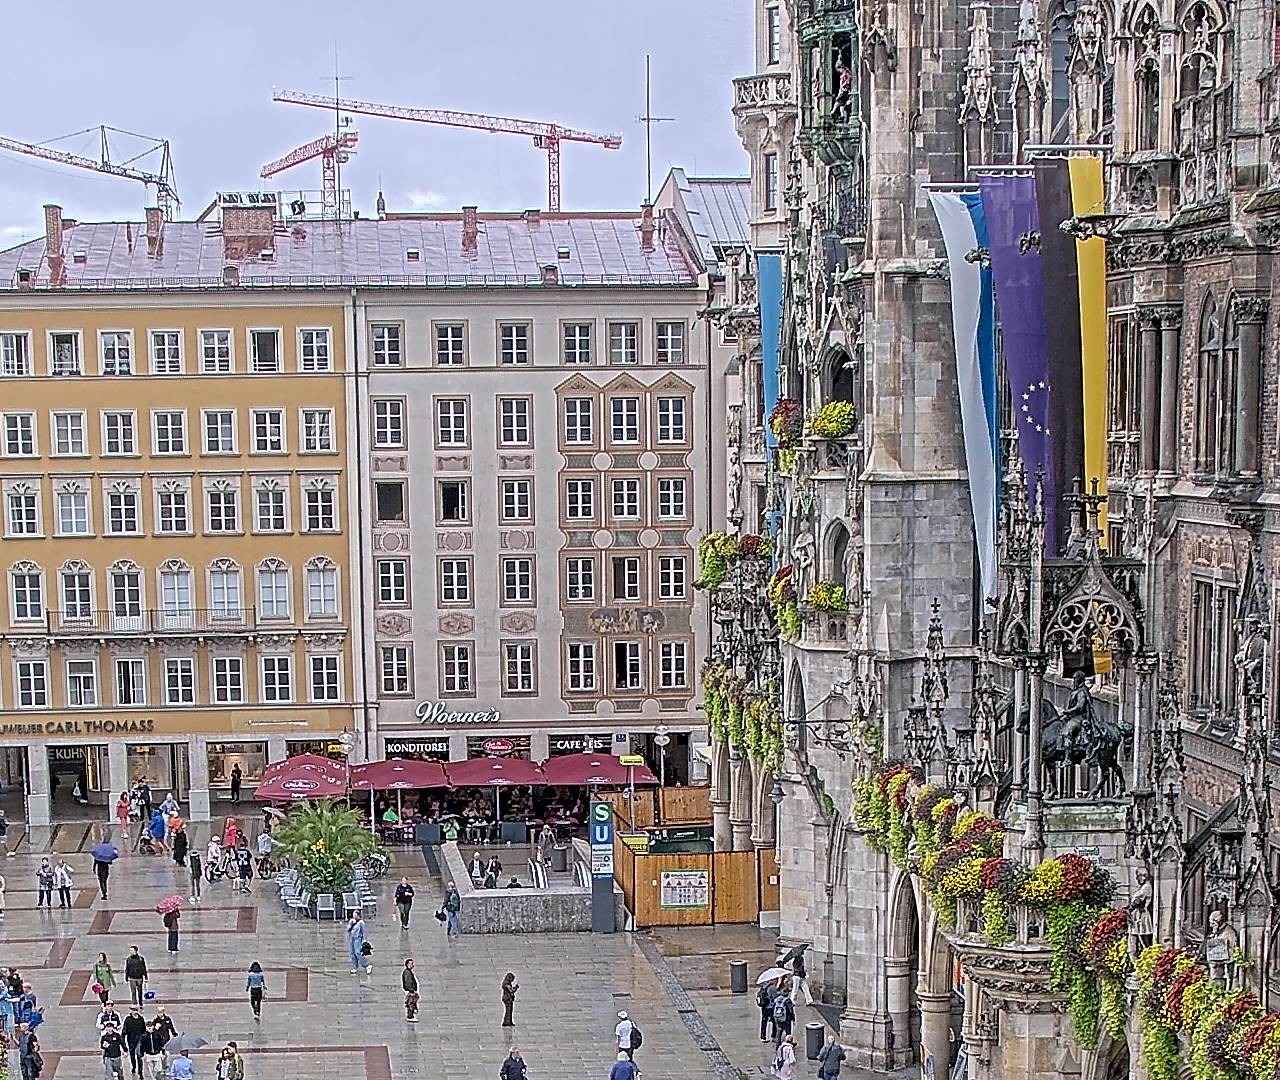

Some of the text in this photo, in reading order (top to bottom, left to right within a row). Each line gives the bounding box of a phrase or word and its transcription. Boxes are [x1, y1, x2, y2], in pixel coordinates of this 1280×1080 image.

[415, 701, 500, 723] Woerner's
[45, 721, 82, 734] CARL
[84, 719, 154, 733] THOMASS
[387, 743, 447, 753] KONDITOREI
[595, 804, 609, 821] S
[595, 825, 609, 842] U
